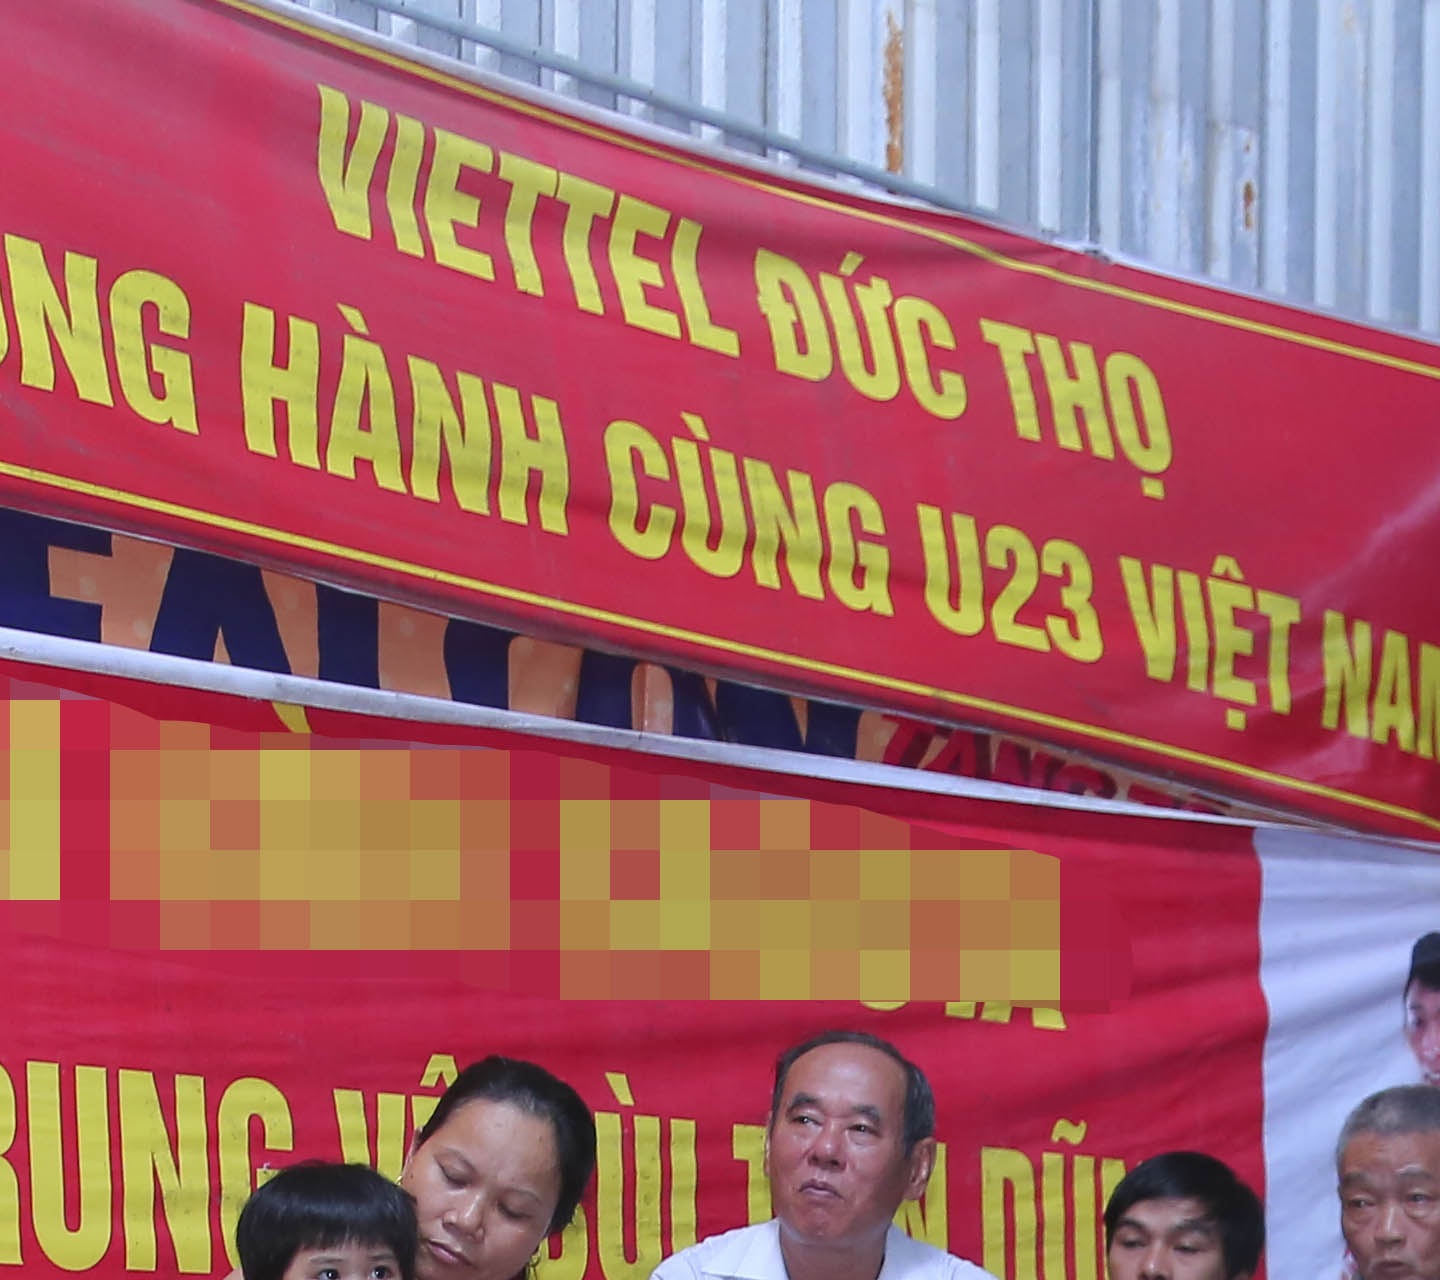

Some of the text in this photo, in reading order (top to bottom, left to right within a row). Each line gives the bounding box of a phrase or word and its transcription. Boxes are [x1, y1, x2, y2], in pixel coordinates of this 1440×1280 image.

[318, 87, 1173, 499] VIETTEL ĐỨC THỌ
[241, 303, 570, 535] HÀNH
[606, 411, 895, 617] CÙNG
[917, 503, 1105, 664] U23
[1120, 555, 1302, 732] VIỆT
